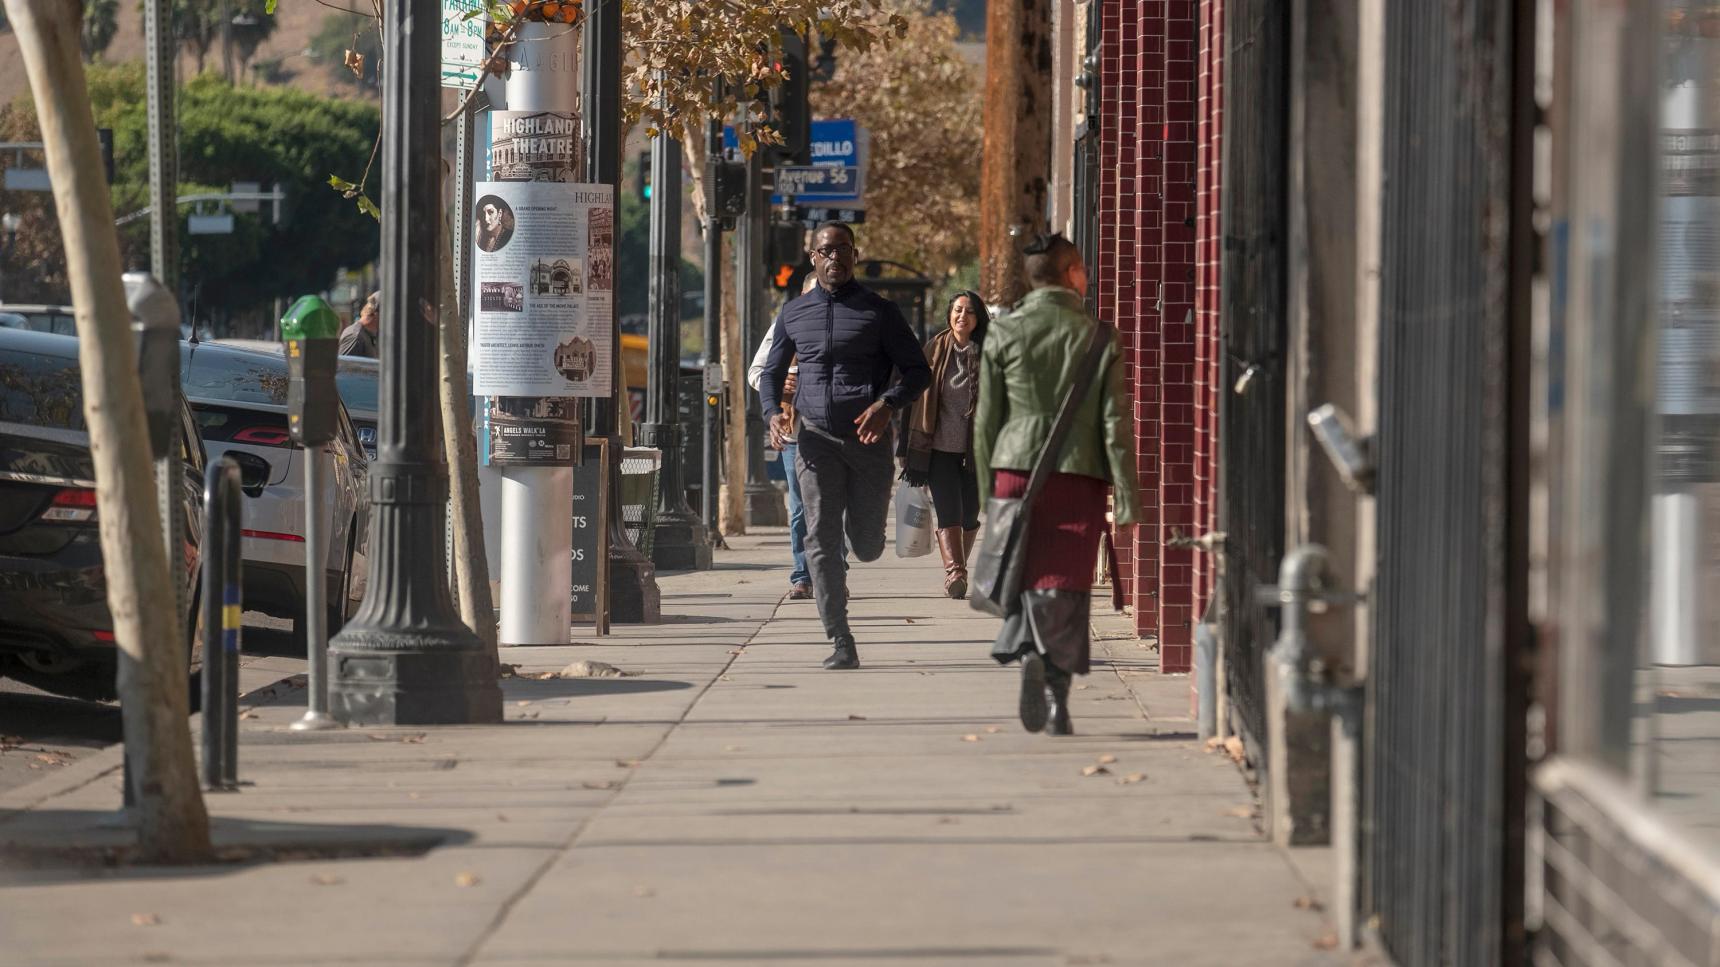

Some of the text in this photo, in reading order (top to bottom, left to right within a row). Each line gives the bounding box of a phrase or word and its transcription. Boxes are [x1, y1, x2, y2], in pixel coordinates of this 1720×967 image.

[444, 0, 481, 10] PARKIN
[503, 118, 573, 134] HIGHLAND
[512, 138, 573, 154] THEATRE
[779, 169, 848, 184] Avenue 56
[572, 516, 587, 529] TS
